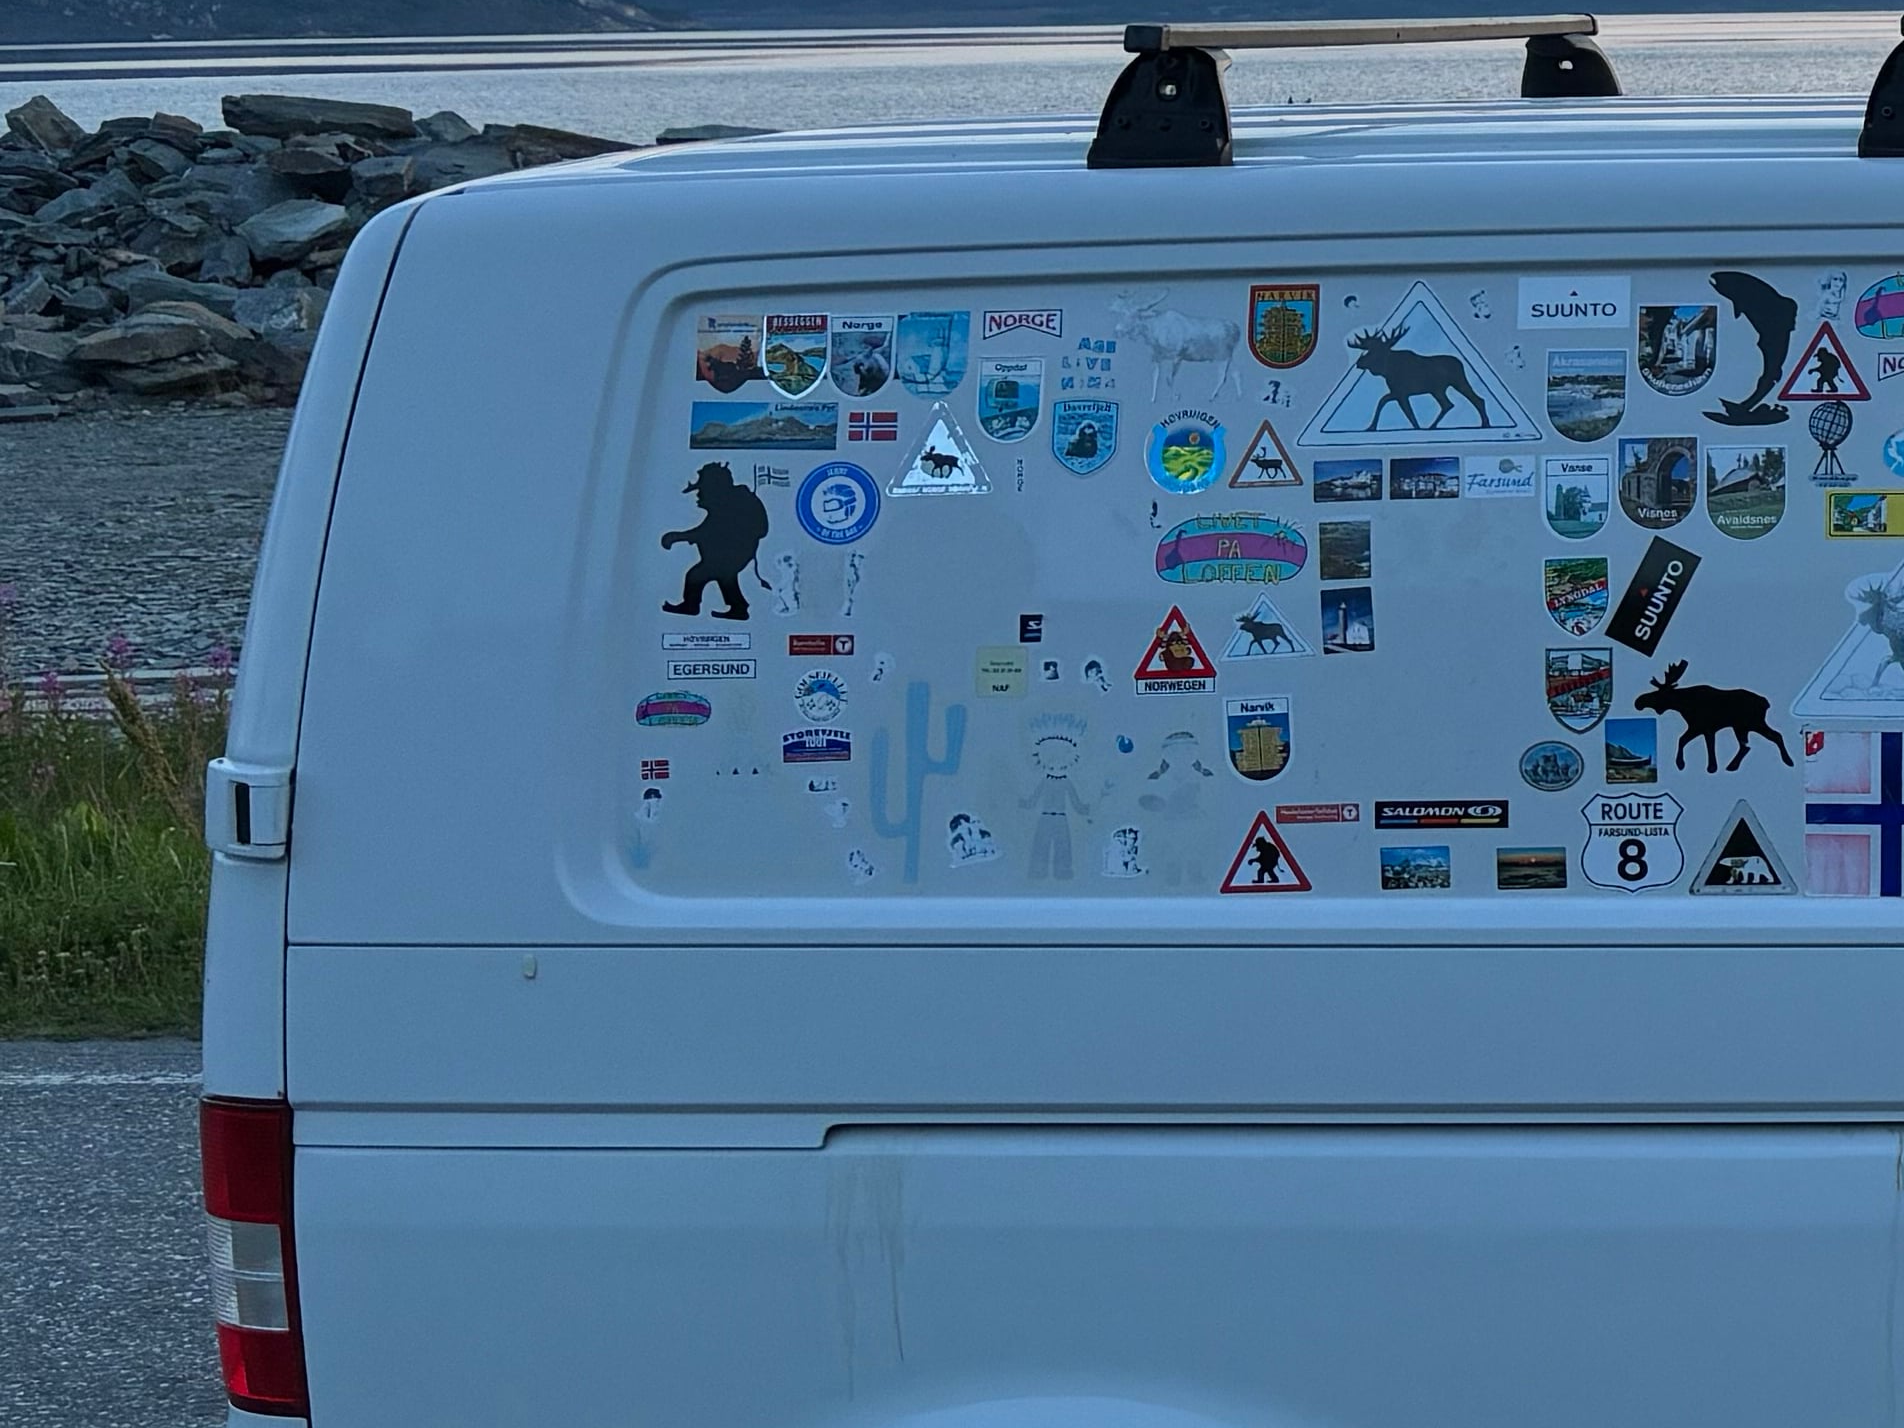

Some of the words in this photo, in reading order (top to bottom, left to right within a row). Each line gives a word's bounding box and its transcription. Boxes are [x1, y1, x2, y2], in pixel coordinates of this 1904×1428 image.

[1257, 291, 1314, 301] NARVIK
[1530, 302, 1617, 318] SUUNTO
[842, 321, 883, 331] Norge
[988, 312, 1058, 332] NORGE
[994, 362, 1028, 373] Oppdal
[1063, 402, 1112, 413] Dovrefjell
[1561, 462, 1593, 473] Vanse
[1466, 471, 1535, 491] Farsund
[1637, 507, 1678, 519] Visnes
[1195, 511, 1267, 530] LIVET
[1717, 514, 1777, 526] Avaldsnes
[1182, 563, 1282, 586] LOFFEN
[1555, 582, 1604, 608] LYNGDAL
[1634, 559, 1684, 641] SUUNTO
[673, 663, 751, 676] EGERSUND
[1144, 679, 1207, 691] NORWEGEN
[1240, 700, 1276, 713] Narvik
[1381, 806, 1465, 817] SALOMON
[1601, 802, 1664, 821] ROUTE
[1598, 827, 1670, 838] FARSUND-LISTA
[1617, 838, 1649, 882] 8
